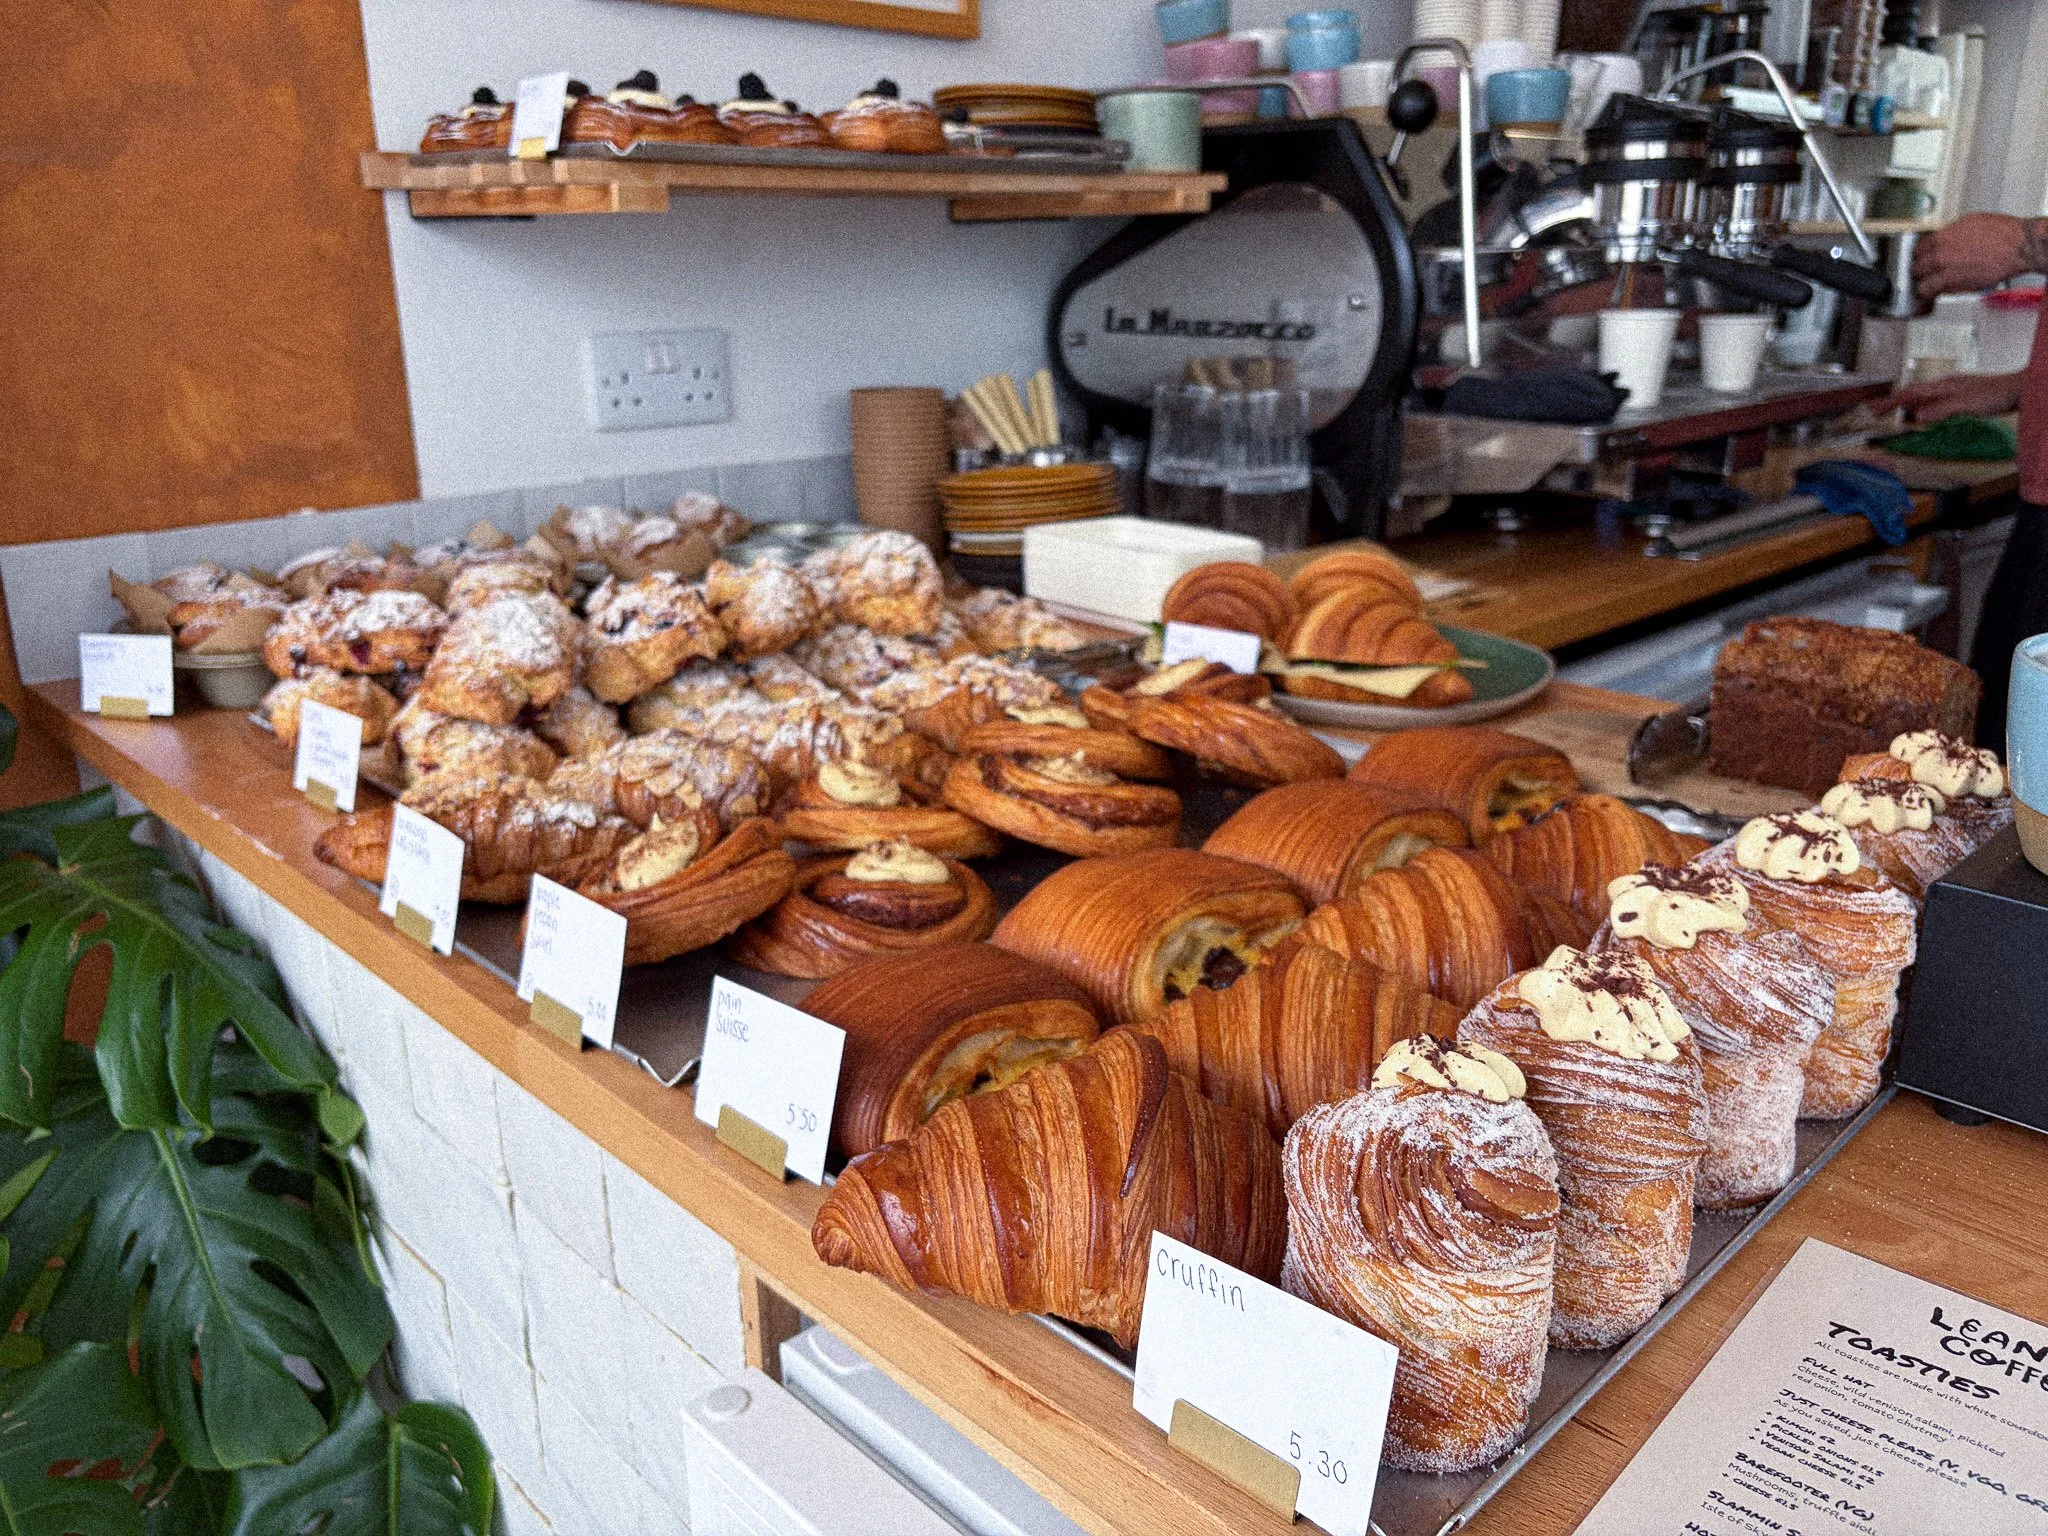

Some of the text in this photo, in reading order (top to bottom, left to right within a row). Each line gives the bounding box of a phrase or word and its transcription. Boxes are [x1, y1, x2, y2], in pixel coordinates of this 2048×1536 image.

[1802, 1356, 1876, 1389] FULL HAT
[1814, 1341, 1831, 1351] All
[1834, 1348, 1880, 1371] toasties
[1882, 1369, 1901, 1380] are
[1902, 1377, 1934, 1394] made
[1936, 1391, 1962, 1405] with
[1964, 1402, 1997, 1420] white
[1828, 1321, 2000, 1399] TOASTIES
[1775, 1415, 1817, 1437] KIMCHI
[1818, 1435, 1836, 1446] £2
[1778, 1388, 1821, 1409] JUST
[1820, 1408, 1876, 1435] CHEESE
[1878, 1432, 1936, 1461] PLEASE
[1791, 1373, 1948, 1443] red onion, tomato chutney
[1797, 1365, 2006, 1458] Cheese, wild venison salami, pickled
[1289, 1430, 1348, 1485] 5.30
[1759, 1438, 1796, 1459] VEGAN
[1797, 1458, 1838, 1479] CHEESE
[1765, 1430, 1811, 1455] VENISON
[1812, 1452, 1855, 1476] SALAMI
[1857, 1474, 1875, 1486] £2
[1770, 1423, 1815, 1446] PICKLED
[1817, 1445, 1860, 1466] ONIONS
[1773, 1398, 1967, 1488] As you asked, just cheese please
[1700, 1501, 1725, 1518] Isle
[1727, 1515, 1745, 1525] of
[1707, 1489, 1783, 1531] SLAMMIN
[1727, 1462, 1798, 1502] Mushrooms,
[1802, 1497, 1847, 1523] truffle
[1732, 1477, 1773, 1499] CHEESE
[1734, 1451, 1875, 1522] BAREFOOTER (VG)
